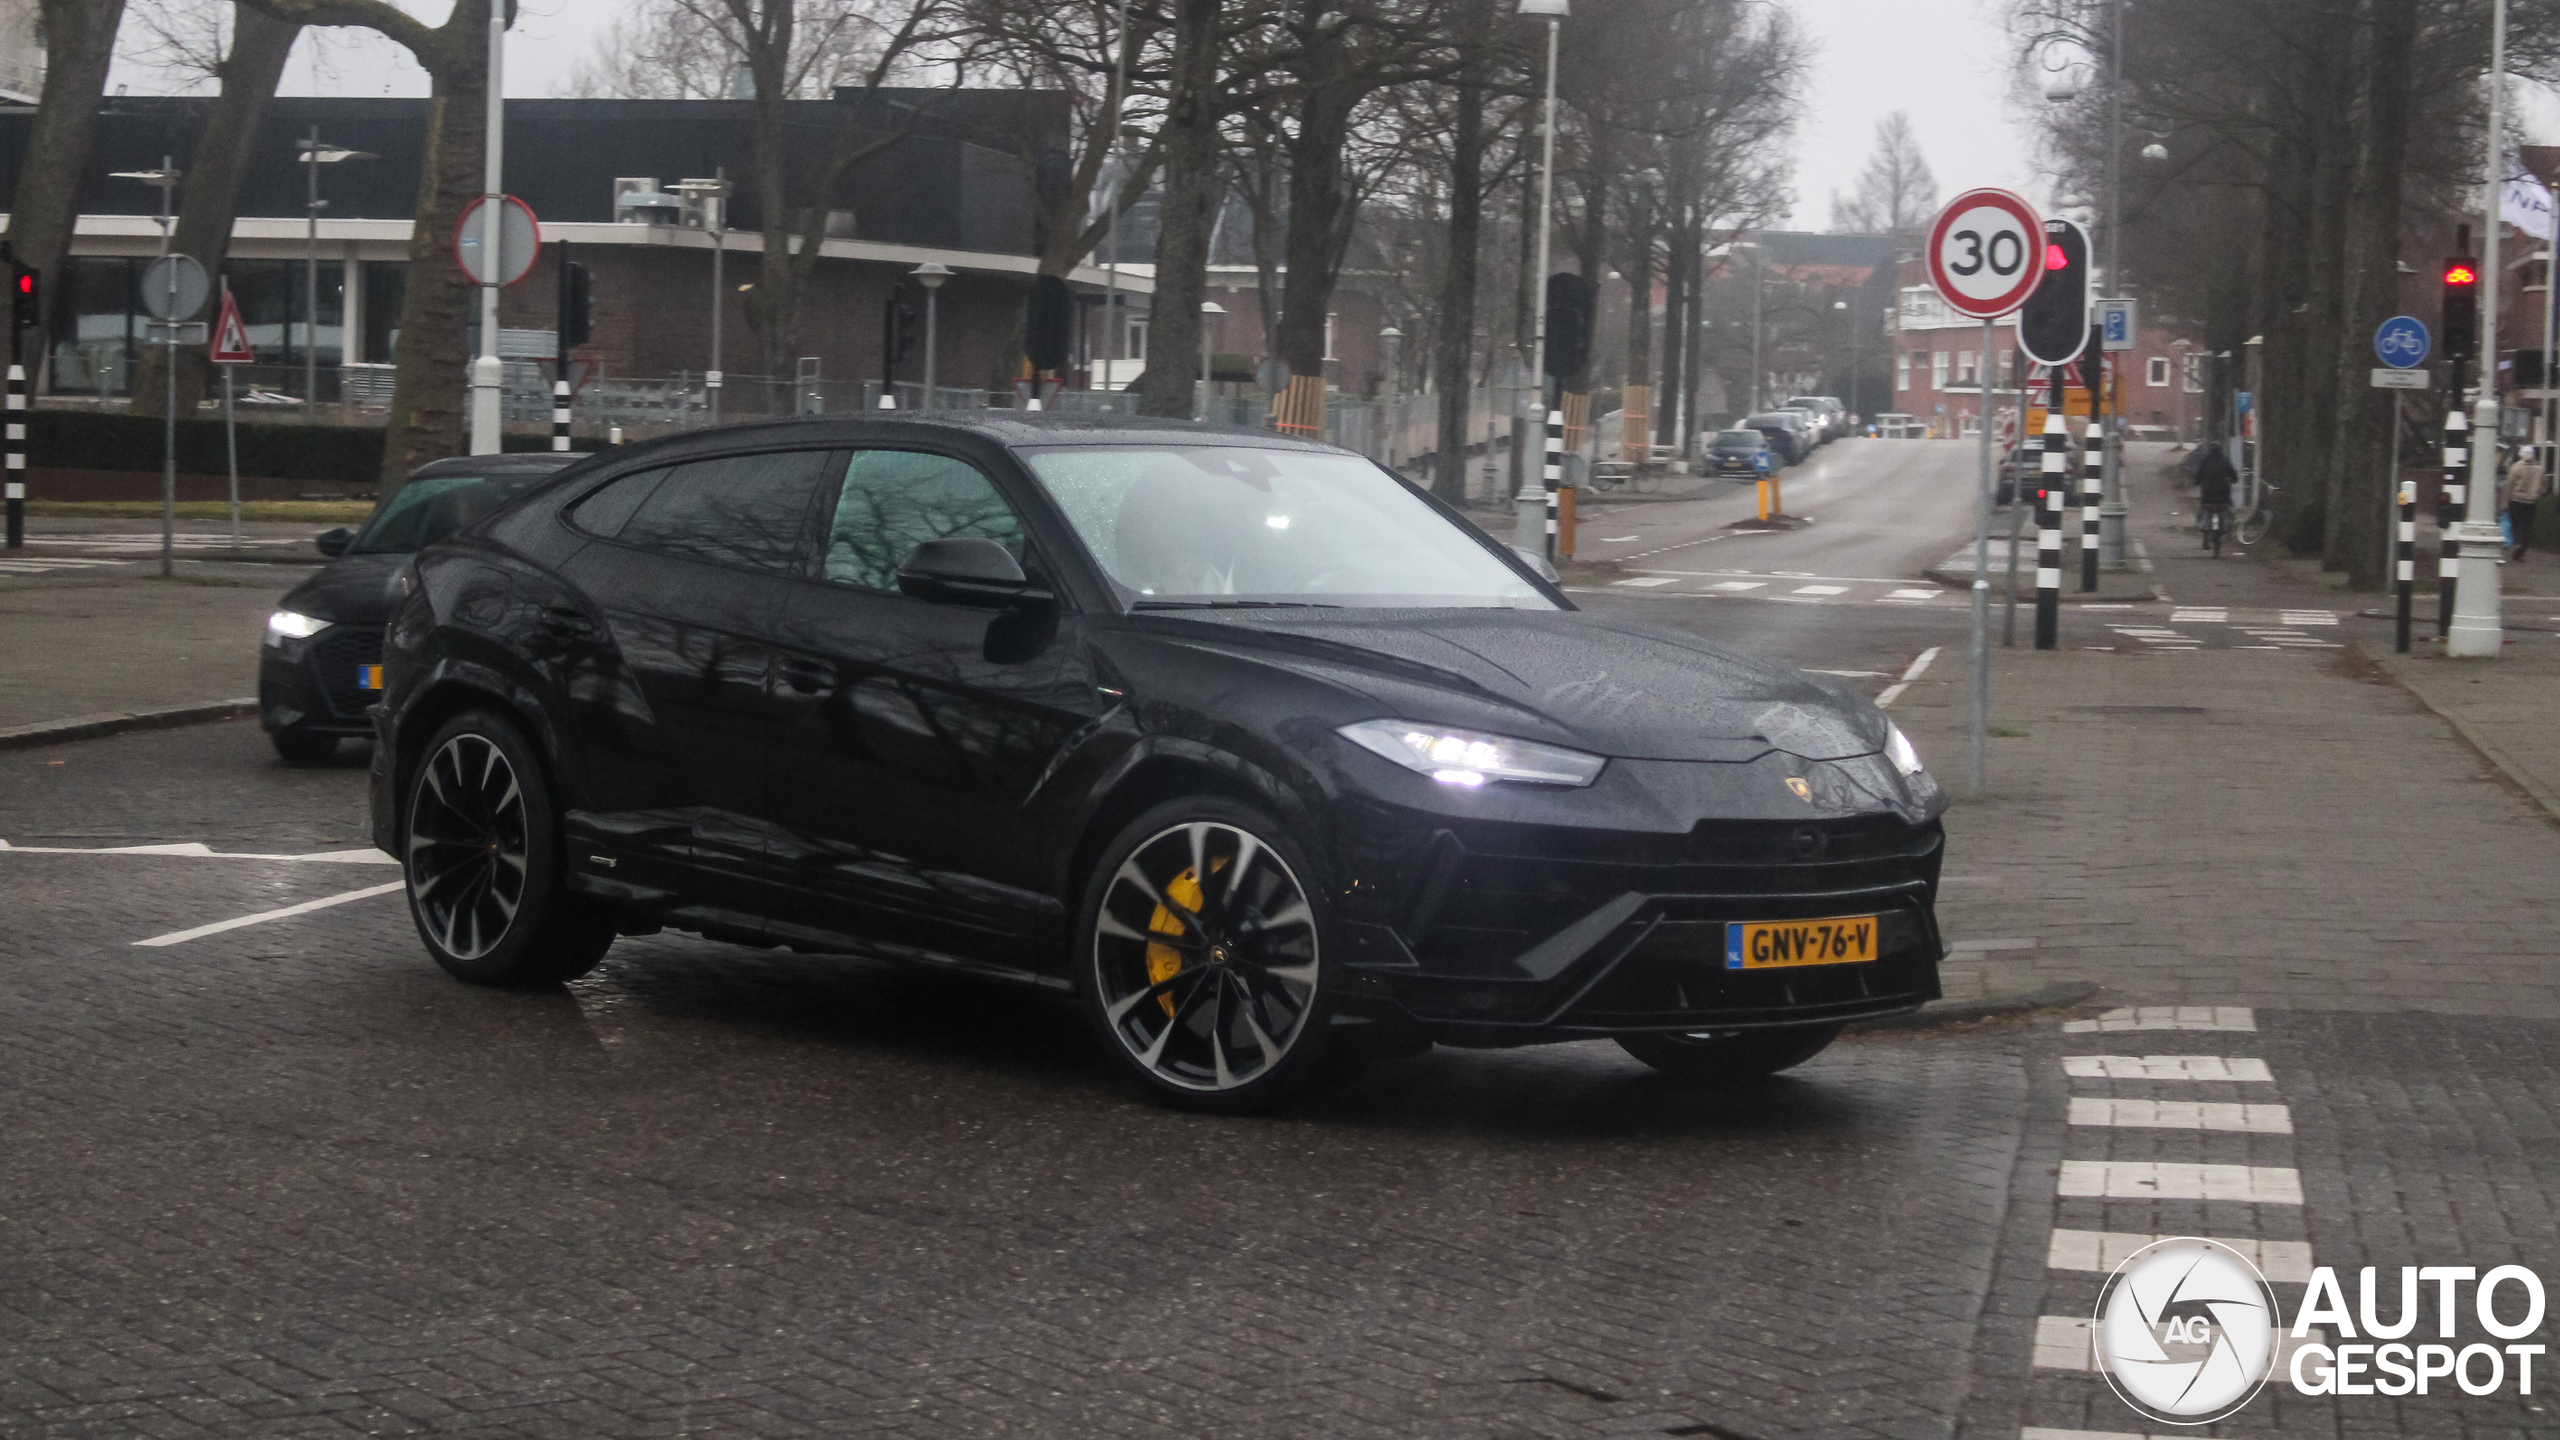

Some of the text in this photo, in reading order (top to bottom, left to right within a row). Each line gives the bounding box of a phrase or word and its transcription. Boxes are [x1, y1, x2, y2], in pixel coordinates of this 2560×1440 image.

[1950, 229, 2023, 276] 30
[2109, 312, 2121, 329] P
[1752, 923, 1870, 963] GNV-76-V
